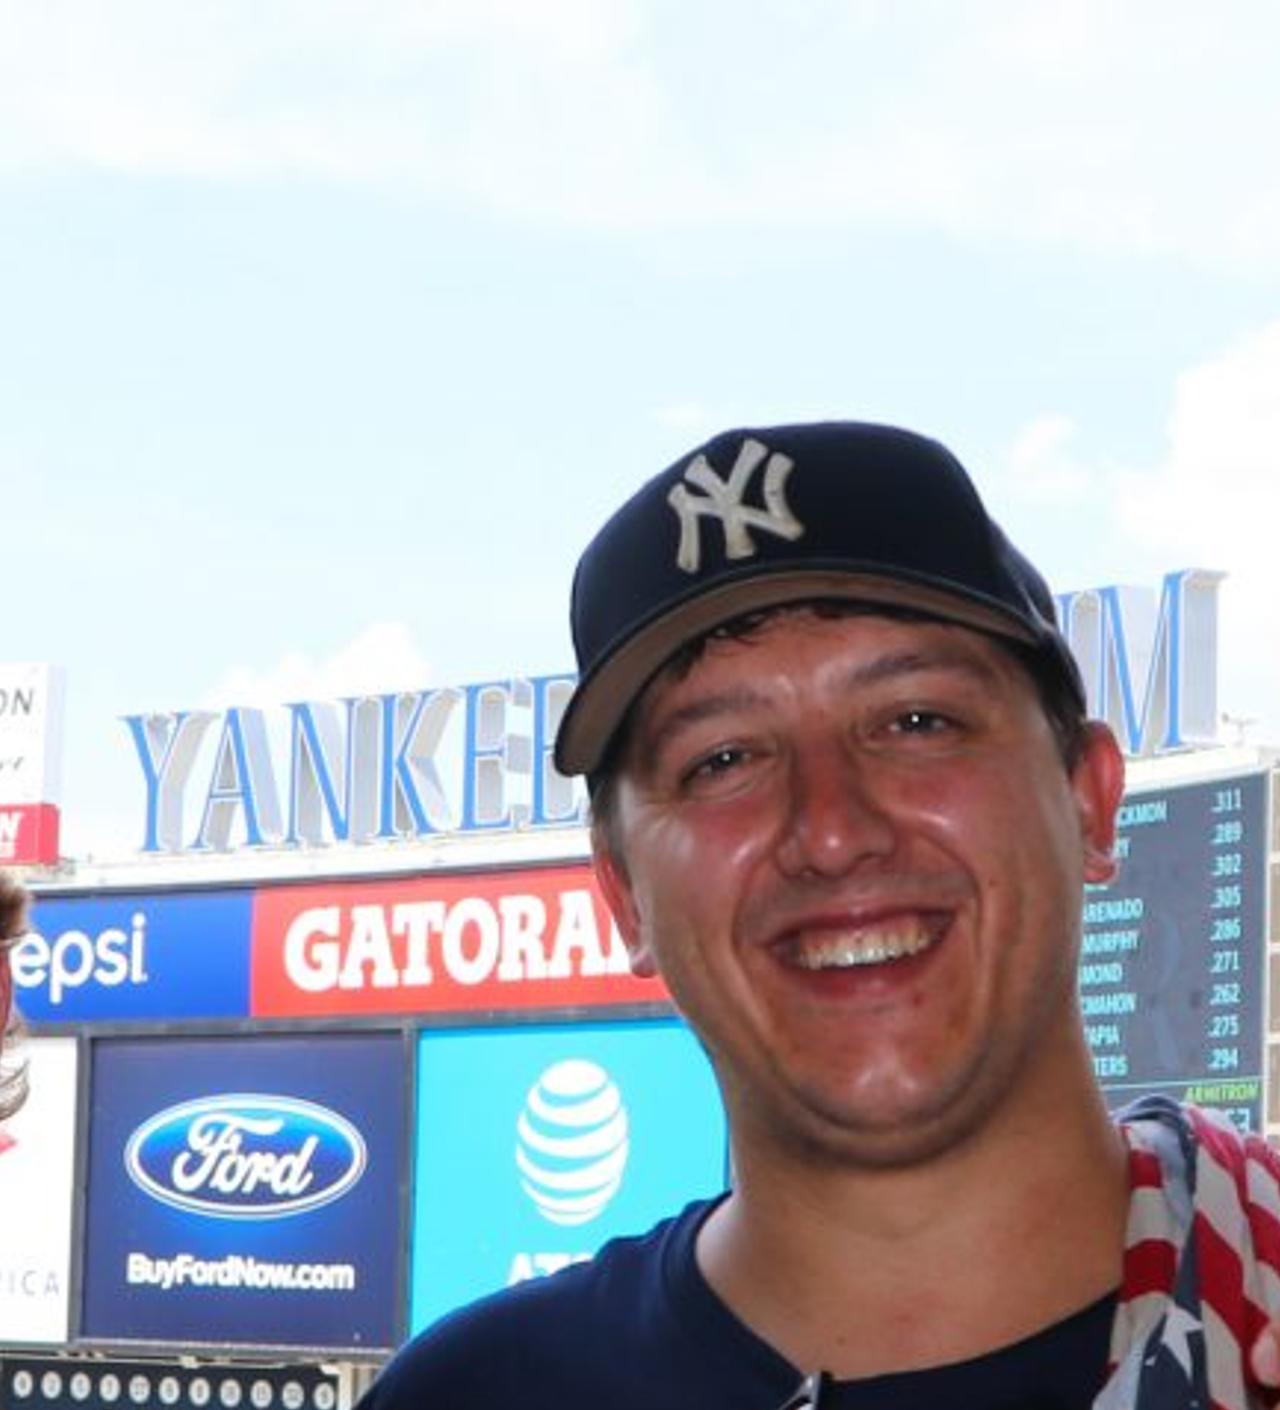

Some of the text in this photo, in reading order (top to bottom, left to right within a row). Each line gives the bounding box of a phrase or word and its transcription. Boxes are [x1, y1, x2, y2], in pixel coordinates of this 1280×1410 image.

[667, 438, 803, 573] NY
[172, 1112, 320, 1196] Ford
[126, 1252, 355, 1294] BuyFordNow.com
